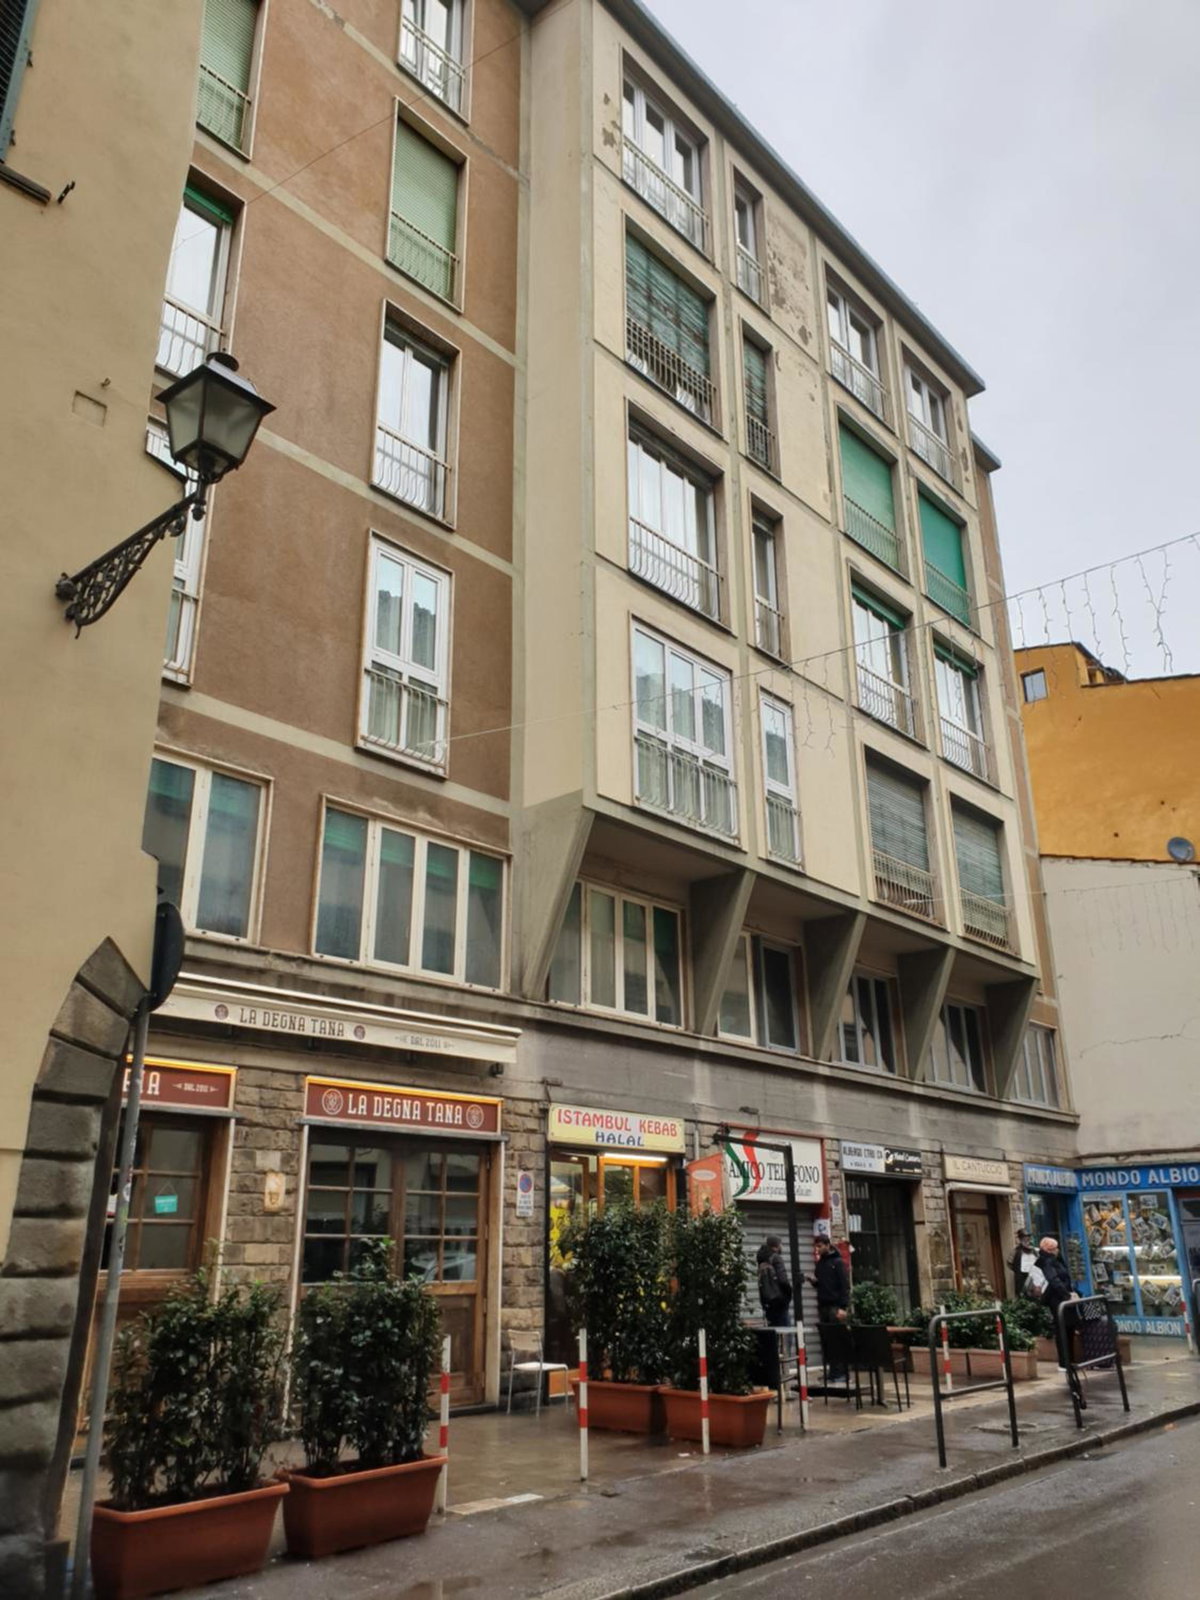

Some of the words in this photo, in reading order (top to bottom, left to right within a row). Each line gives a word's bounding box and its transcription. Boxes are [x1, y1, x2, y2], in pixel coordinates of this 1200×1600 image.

[239, 1007, 257, 1025] LA
[262, 1011, 306, 1032] DEGNA
[310, 1018, 345, 1037] TANA
[347, 1093, 368, 1116] LA
[373, 1096, 421, 1121] DEGNA
[426, 1102, 463, 1125] TANA
[557, 1108, 632, 1132] ISTAMBUL
[639, 1119, 678, 1137] KEBAB
[595, 1131, 645, 1147] HALAL
[766, 1162, 820, 1184] TELFONO
[1081, 1169, 1141, 1187] MONDO
[1145, 1320, 1181, 1335] ALBION
